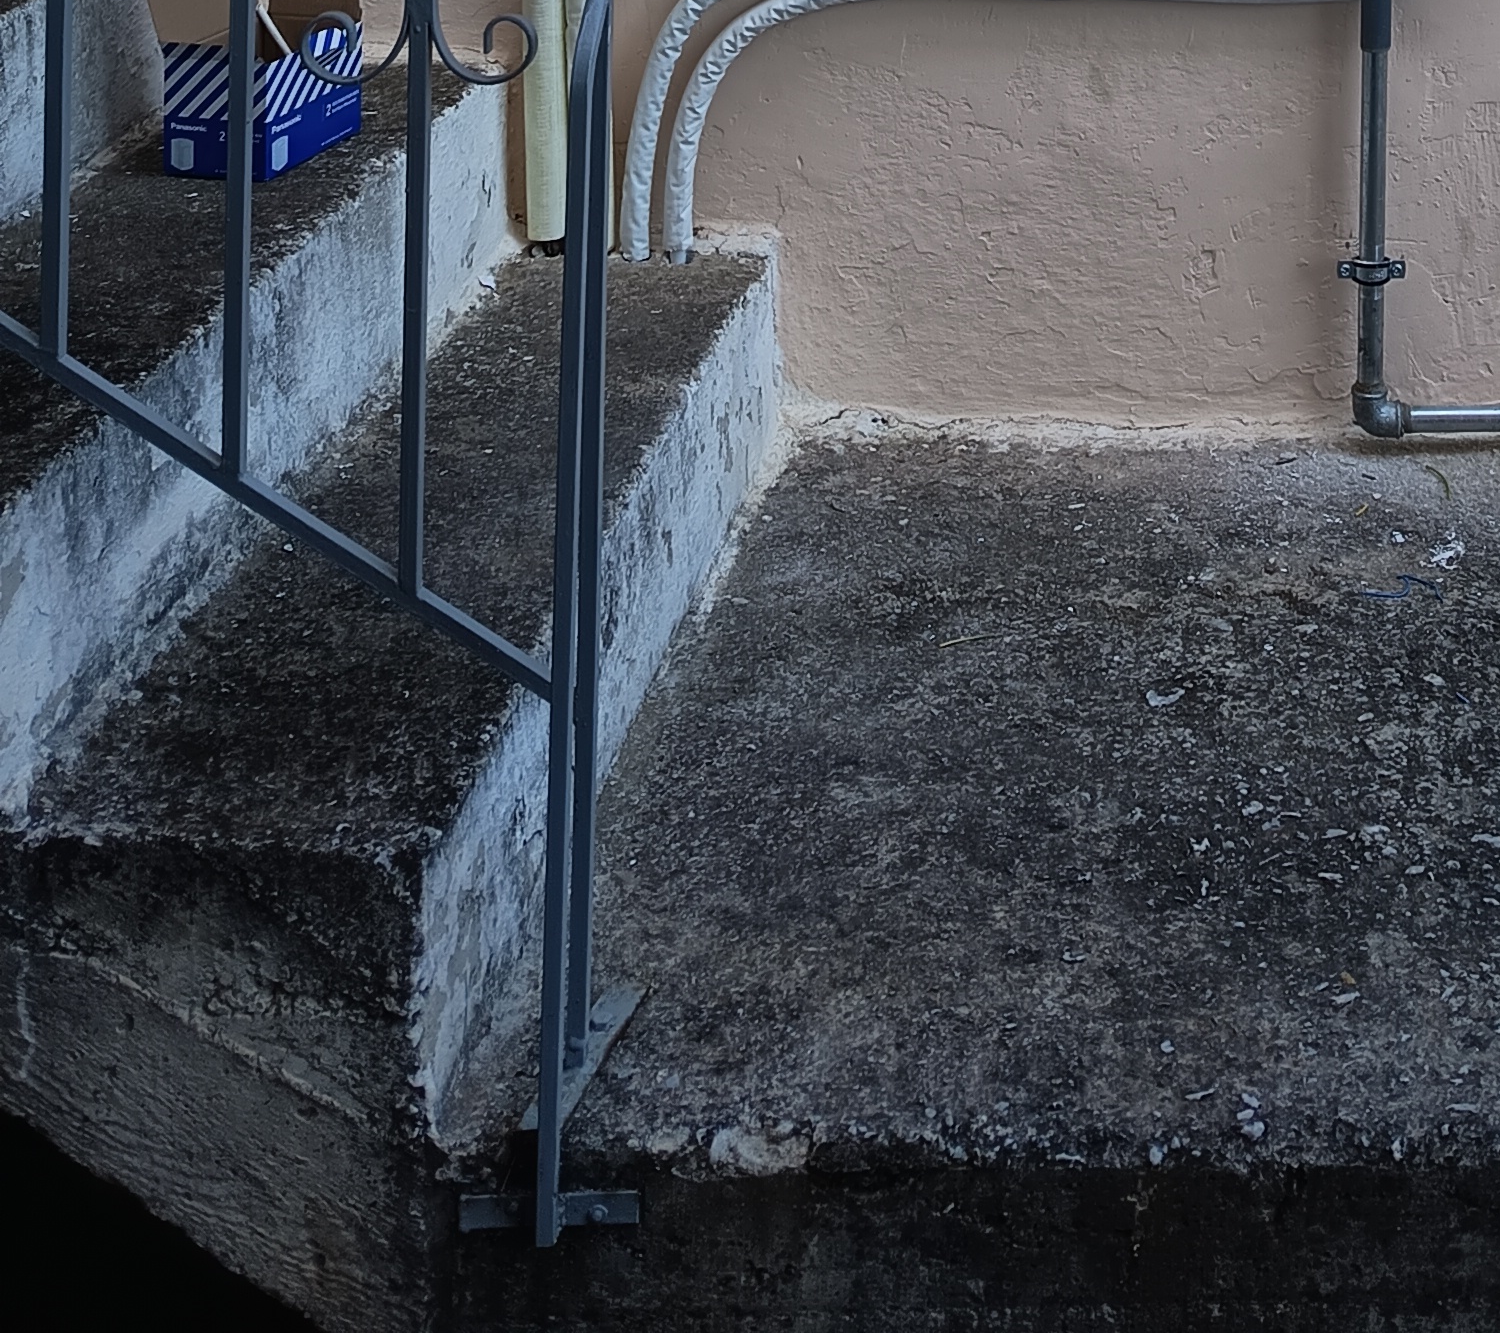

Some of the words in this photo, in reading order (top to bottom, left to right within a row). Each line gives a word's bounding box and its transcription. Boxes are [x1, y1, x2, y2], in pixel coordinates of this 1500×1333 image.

[326, 103, 332, 117] 2
[170, 122, 208, 132] Panasonic
[271, 114, 302, 135] Panasonic
[218, 131, 226, 142] 2
